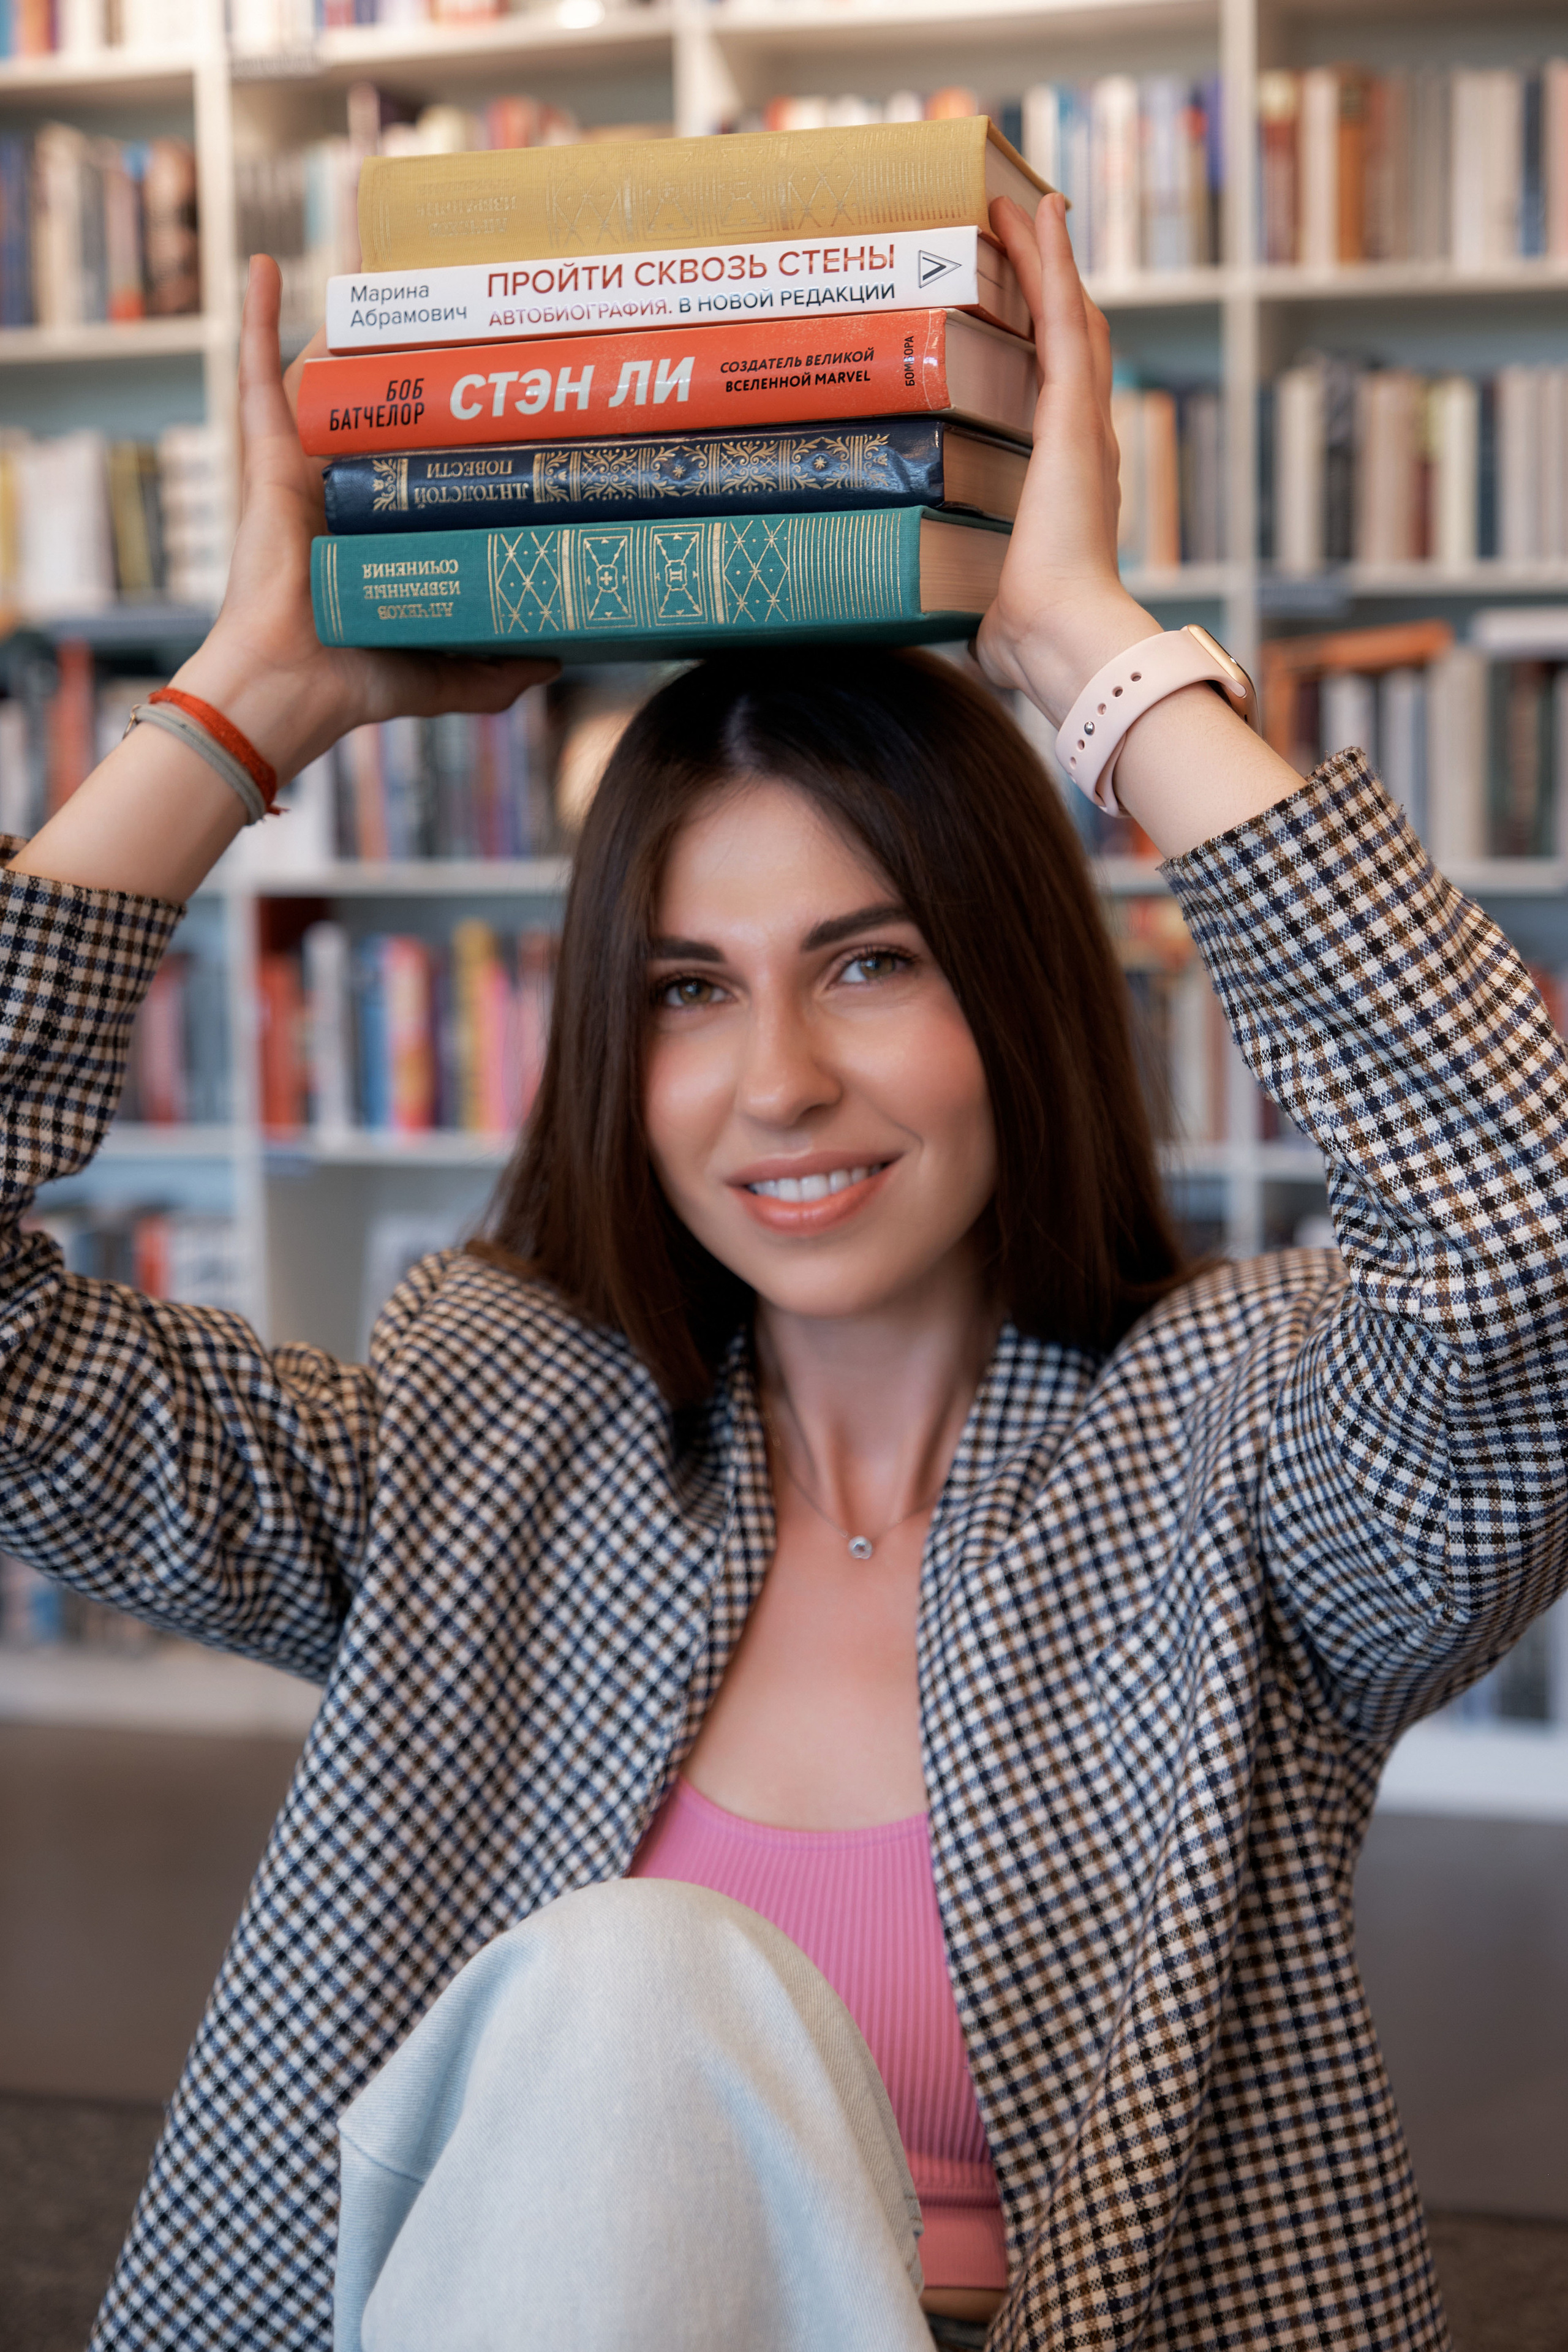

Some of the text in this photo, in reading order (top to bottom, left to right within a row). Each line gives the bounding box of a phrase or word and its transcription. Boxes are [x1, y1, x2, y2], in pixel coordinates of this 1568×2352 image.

[487, 244, 894, 298] ПРОЙТИ СКВОЗЬ СТЕНЫ
[350, 285, 429, 305] Марина
[488, 282, 895, 326] АВТОБИОГРАФИЯ. В НОВОЙ РЕДАКЦИИ
[350, 306, 467, 330] Абрамович
[720, 347, 874, 373] СОЗДАТЕЛЬ ВЕЛИКОЙ
[903, 336, 915, 386] БОМБОРА
[386, 378, 424, 401] БОБ
[450, 356, 695, 420] СТЭН ЛИ
[726, 370, 870, 392] ВСЕЛЕННОЙ MARVEL
[330, 402, 424, 431] БАТЧЕЛОР
[427, 460, 513, 478] ПОВЕСТИ
[361, 559, 459, 579] СОЧИНЕНИЯ
[363, 581, 461, 600] ИЗБРАННЫЕ
